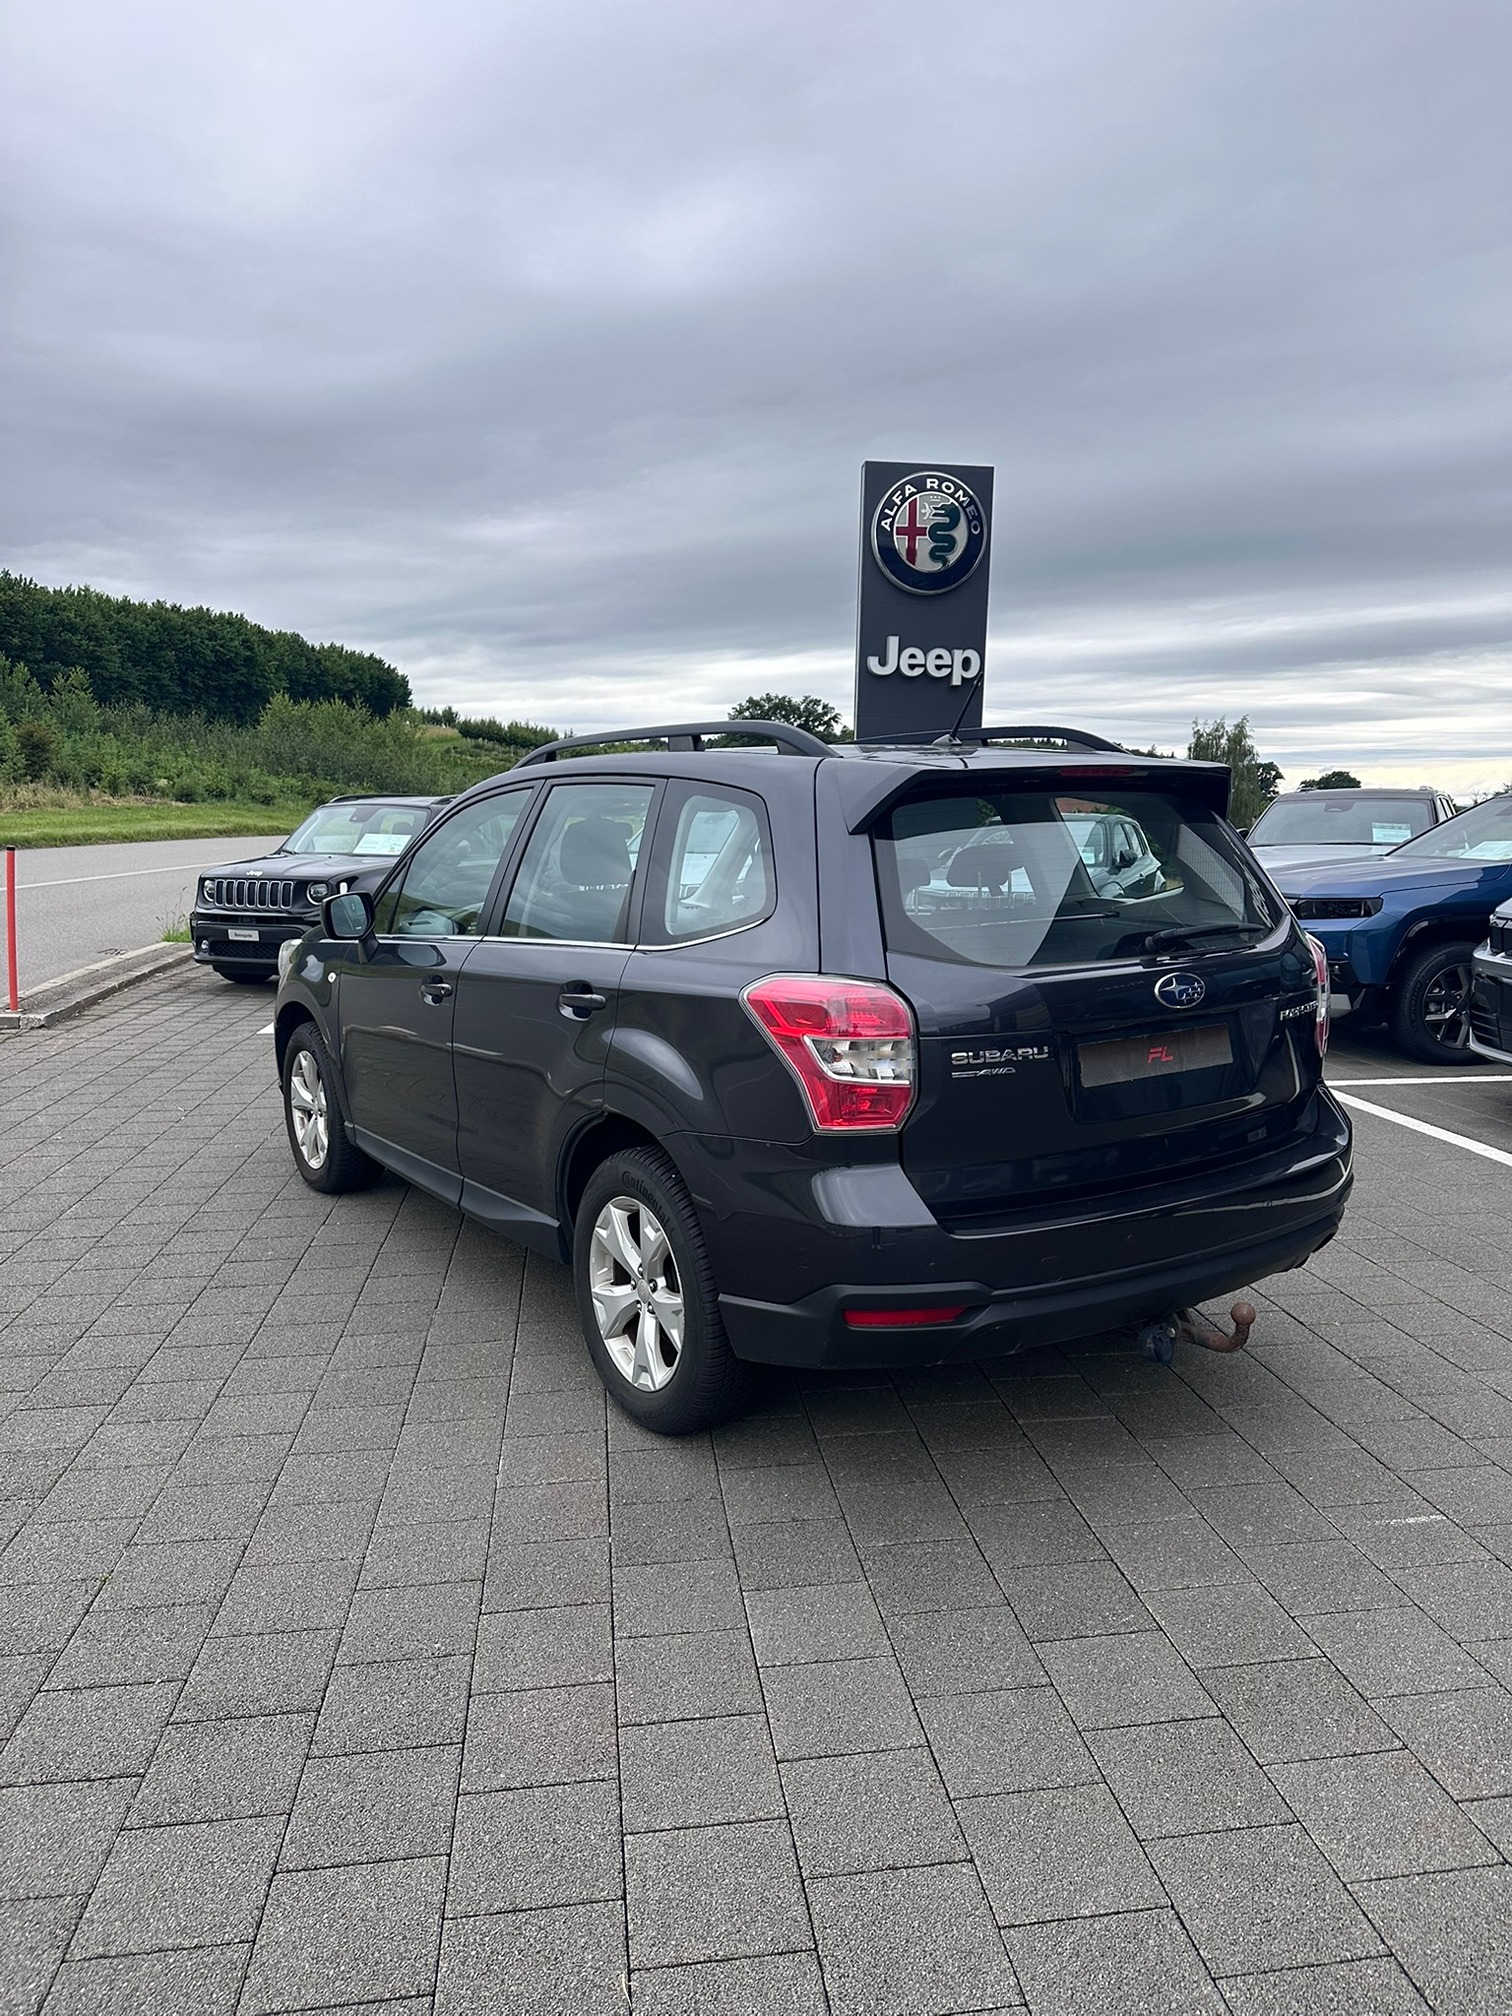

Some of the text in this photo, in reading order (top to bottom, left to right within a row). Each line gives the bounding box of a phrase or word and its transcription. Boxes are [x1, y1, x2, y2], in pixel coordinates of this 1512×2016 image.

[880, 478, 981, 535] ALFA ROMEO
[867, 635, 982, 686] Jeep
[951, 1046, 1049, 1065] SUBARU
[976, 1066, 1017, 1077] AWD
[1147, 1046, 1174, 1064] FL
[621, 1170, 670, 1227] Continental
